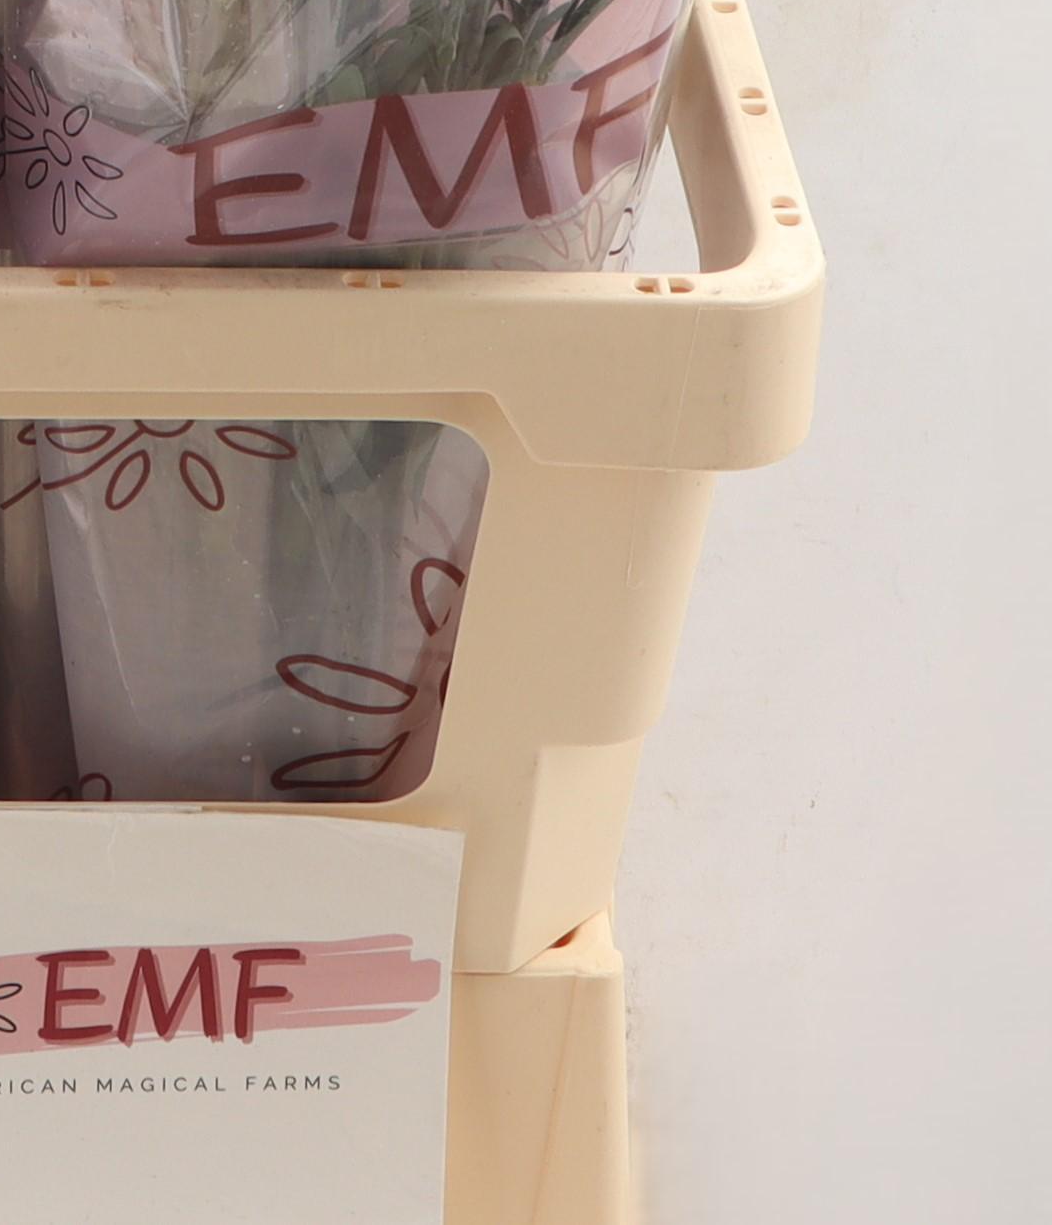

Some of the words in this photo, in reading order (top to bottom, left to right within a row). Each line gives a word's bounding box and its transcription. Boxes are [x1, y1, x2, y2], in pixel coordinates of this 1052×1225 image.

[167, 23, 675, 245] EMF
[35, 947, 307, 1044] EMF
[96, 1076, 228, 1094] MAGICAL
[245, 1074, 343, 1092] FARMS
